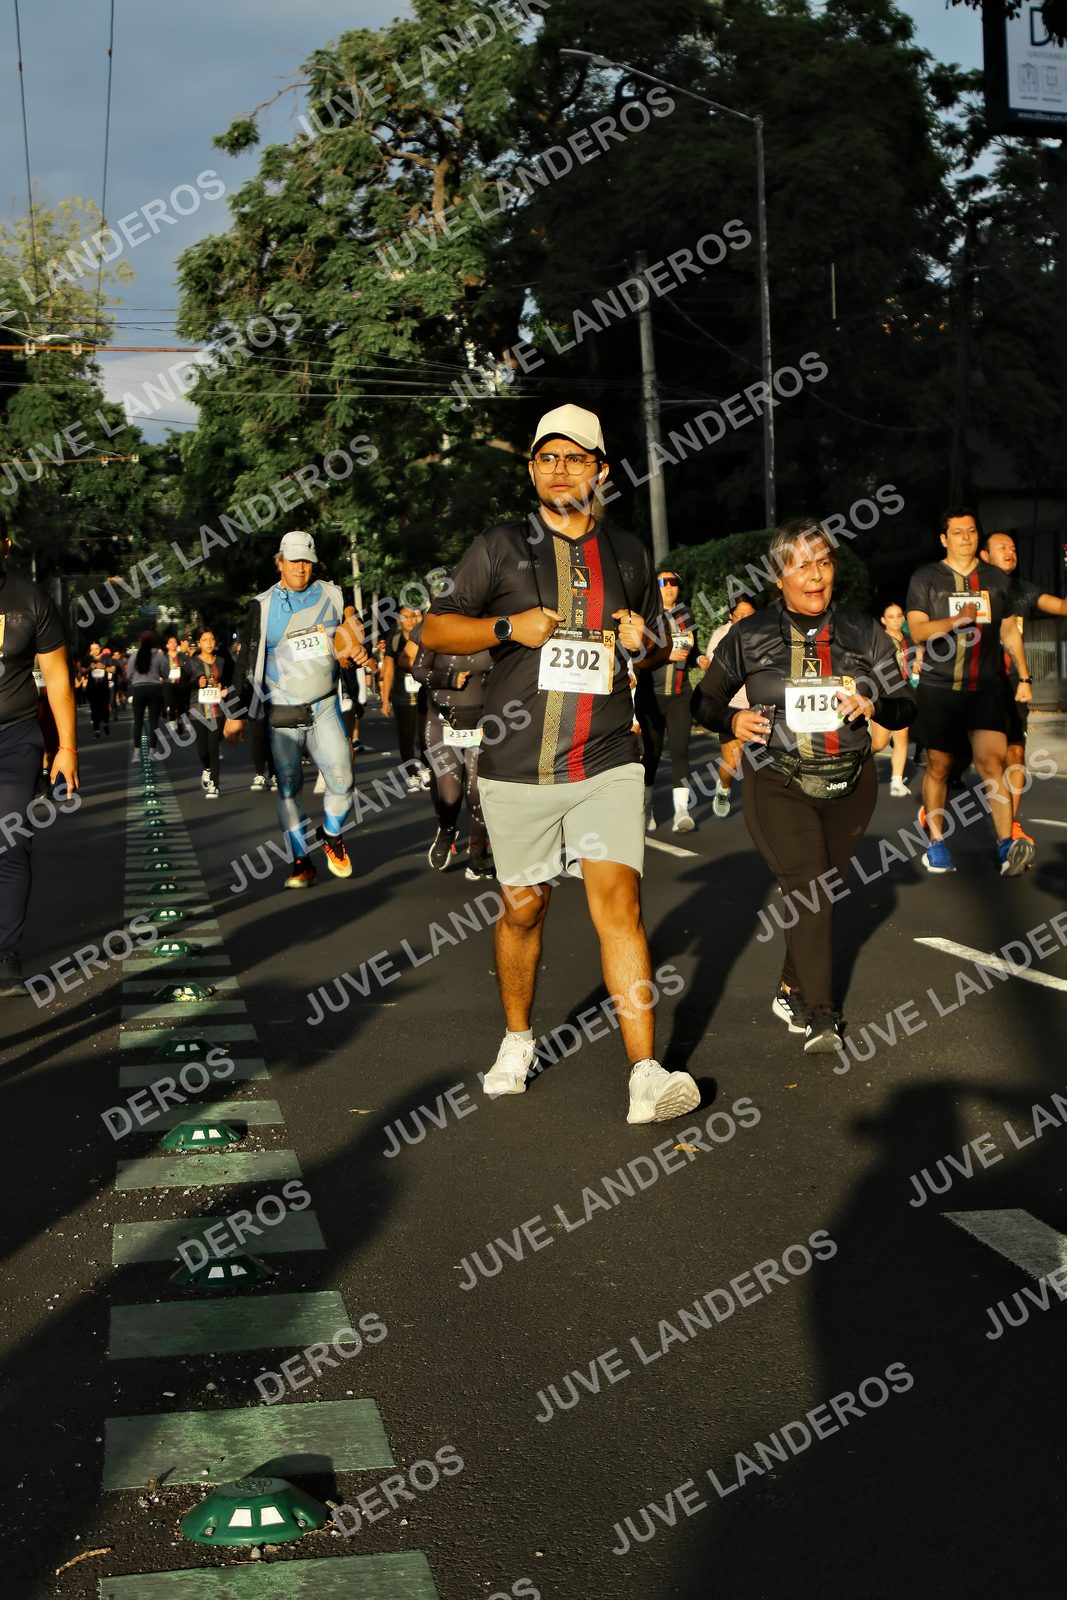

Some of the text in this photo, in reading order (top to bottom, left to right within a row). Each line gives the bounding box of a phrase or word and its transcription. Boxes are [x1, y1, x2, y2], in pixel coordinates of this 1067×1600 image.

[294, 636, 320, 651] 2323
[549, 647, 600, 671] 2302
[449, 730, 474, 738] 2321
[826, 781, 848, 791] Jeep
